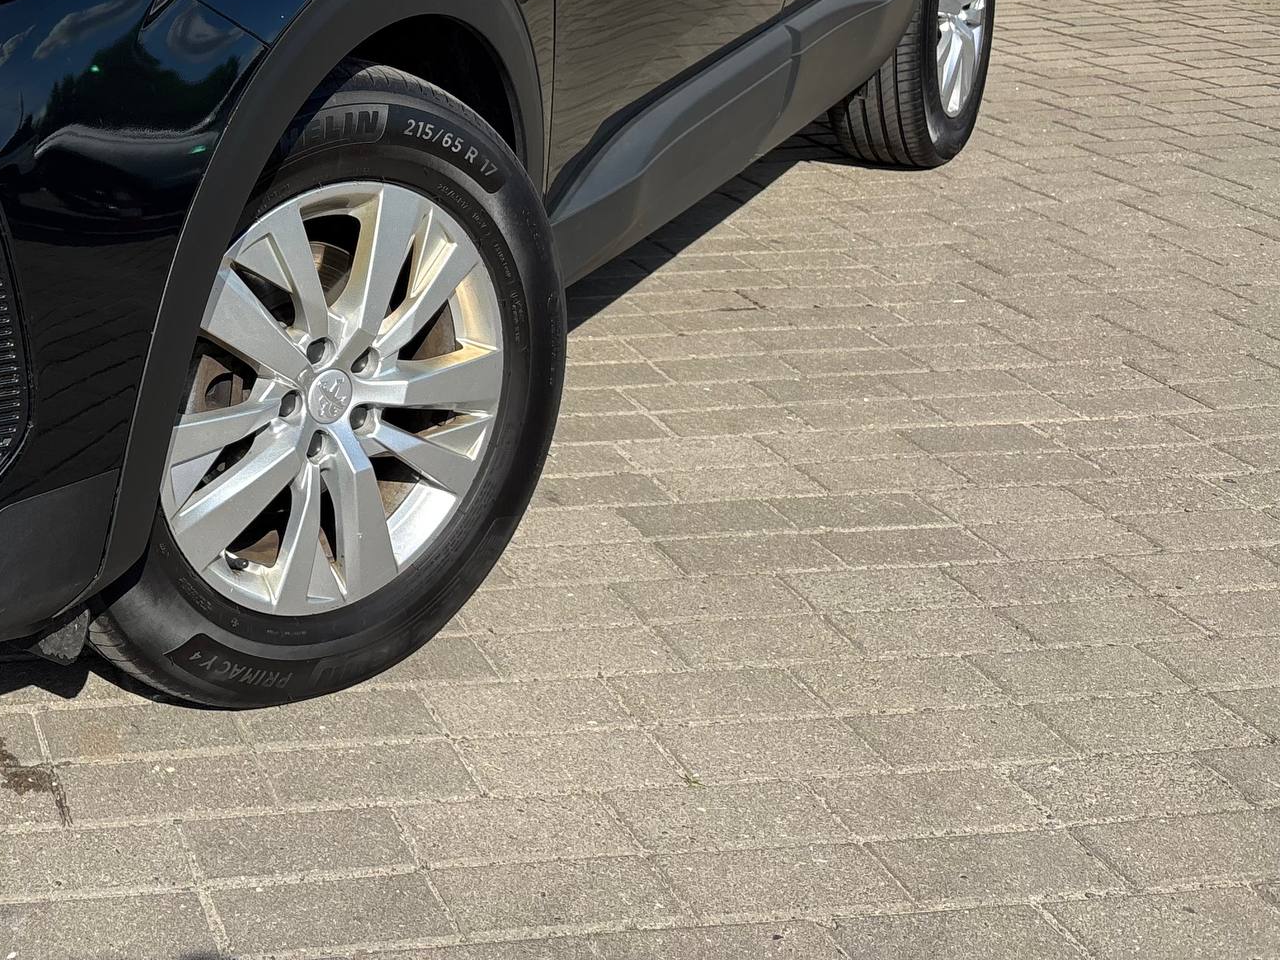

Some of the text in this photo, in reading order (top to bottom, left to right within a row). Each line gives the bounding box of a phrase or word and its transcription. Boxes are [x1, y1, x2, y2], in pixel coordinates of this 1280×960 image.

[403, 119, 498, 176] 215/65 R 17
[189, 650, 293, 689] PRIMACY 4
